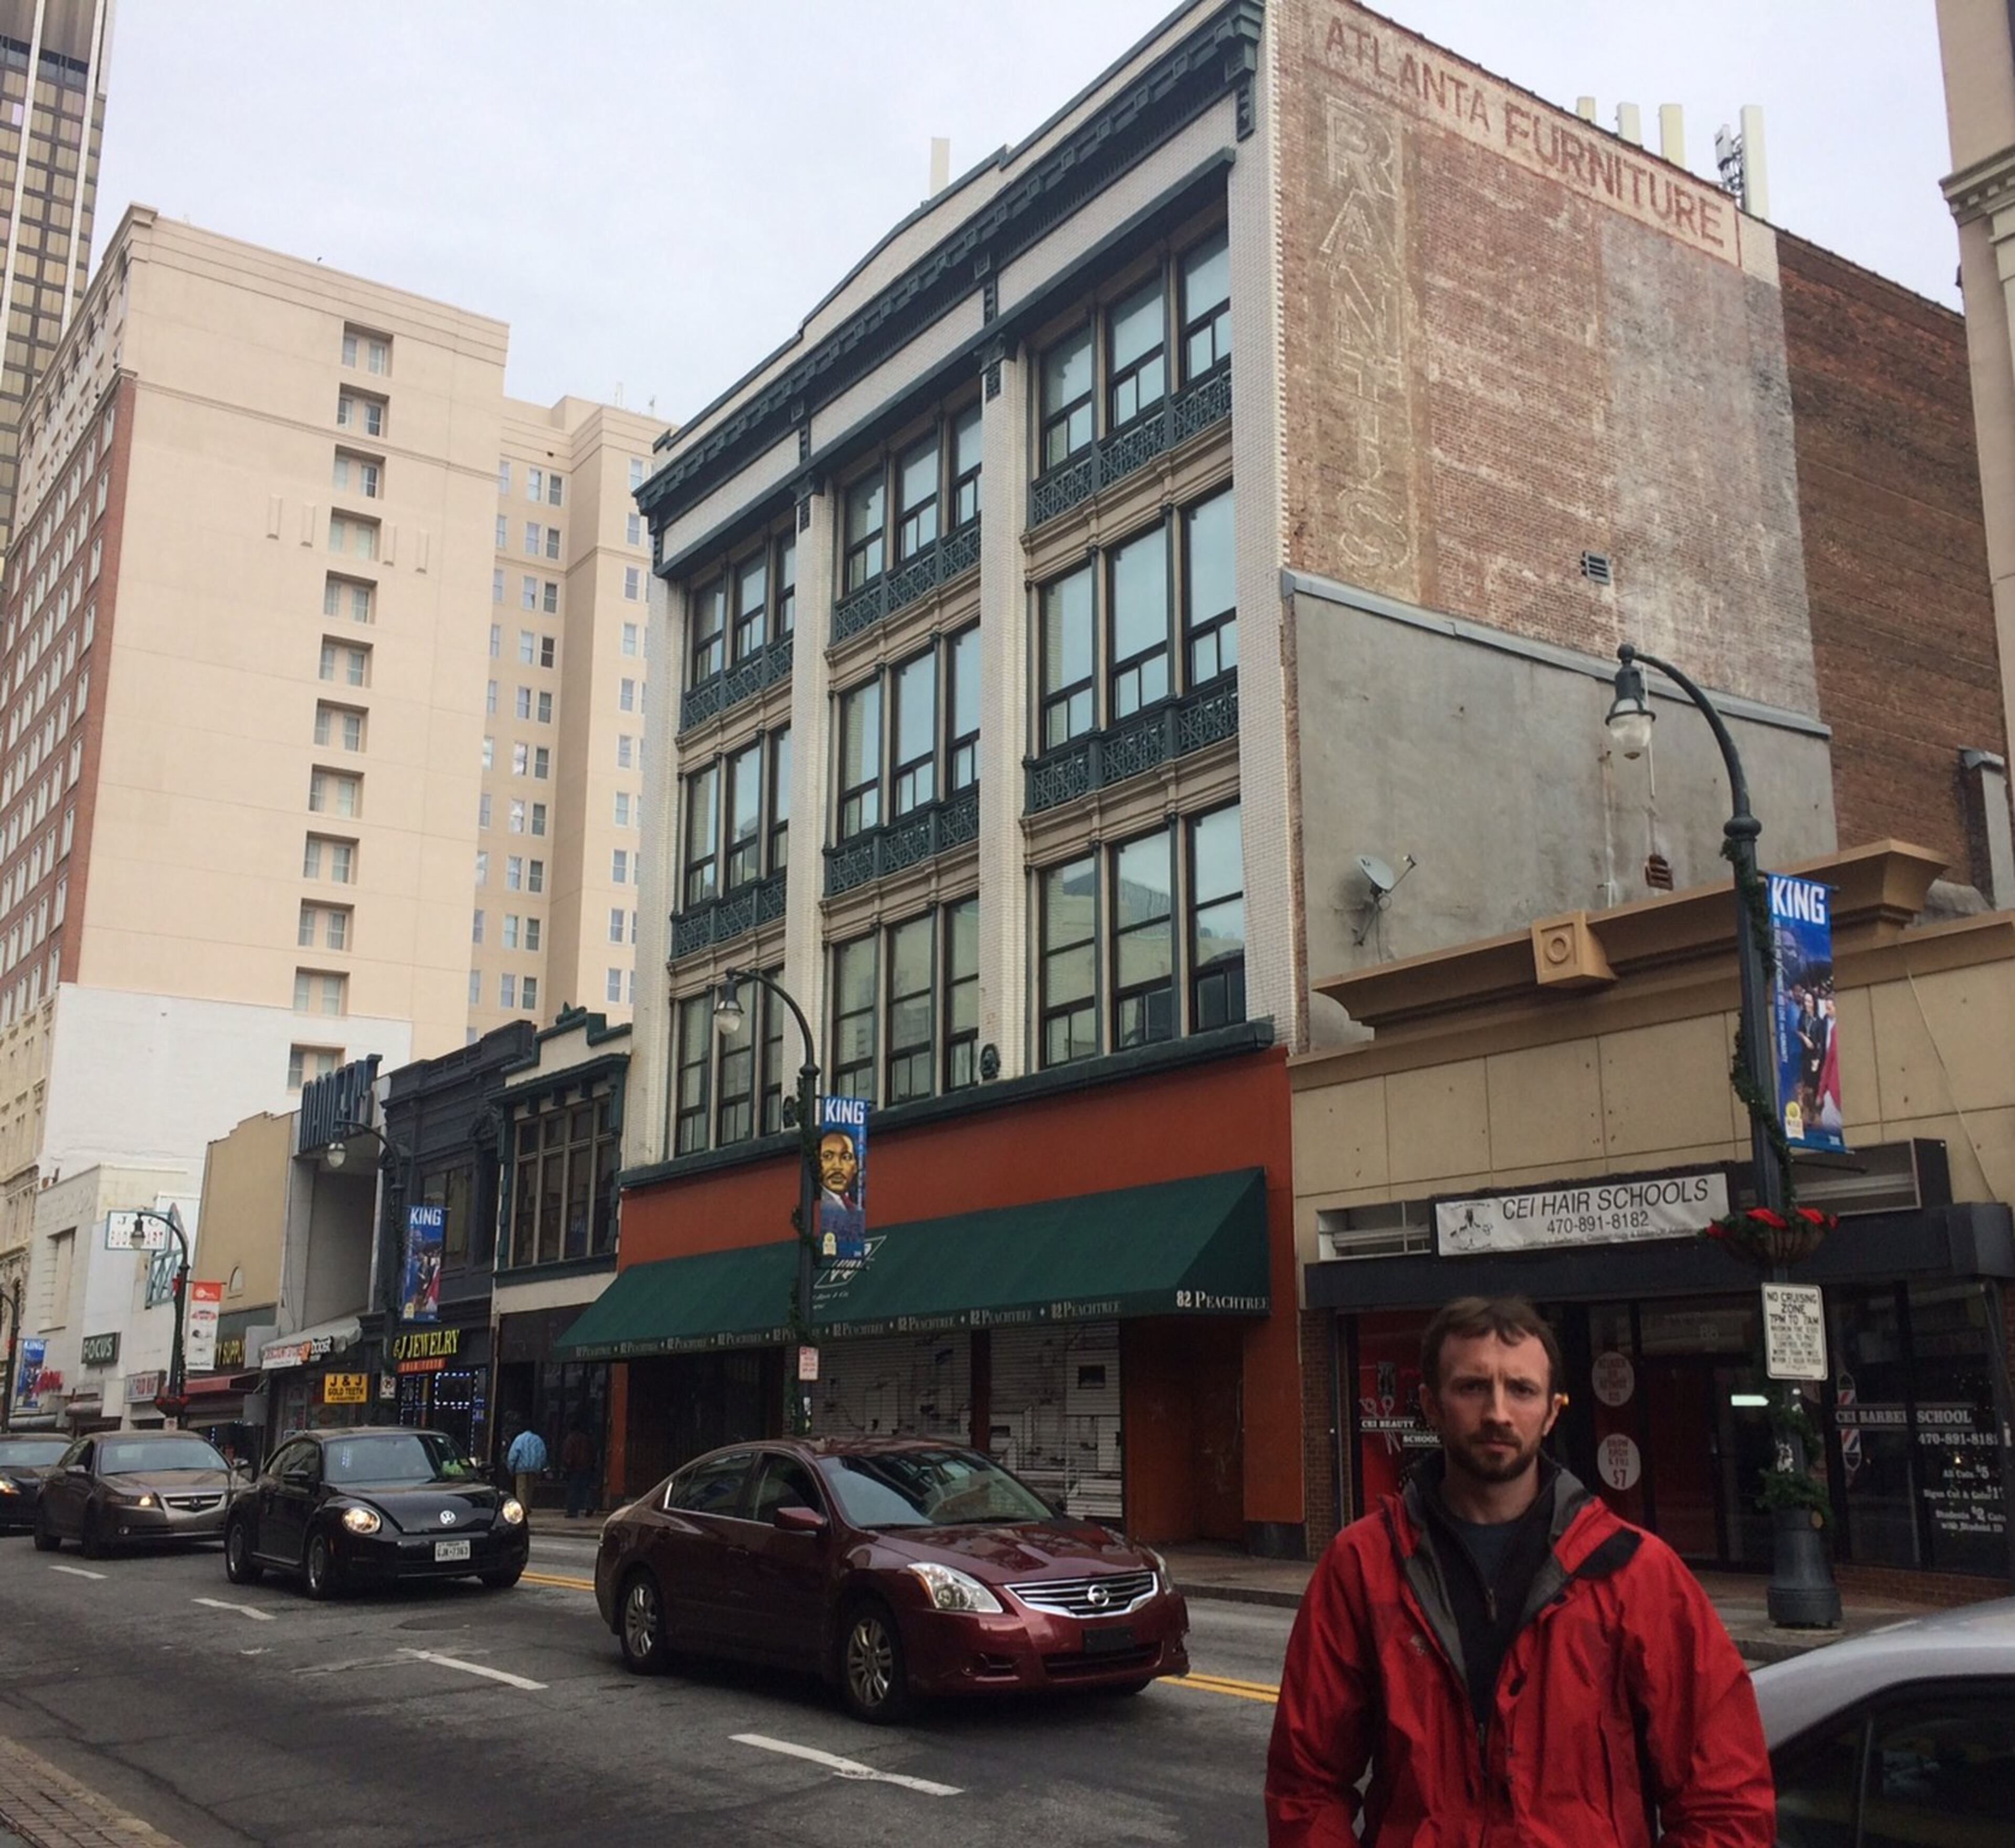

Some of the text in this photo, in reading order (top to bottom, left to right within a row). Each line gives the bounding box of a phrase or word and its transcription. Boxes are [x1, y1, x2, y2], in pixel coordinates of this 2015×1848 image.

[1325, 16, 1725, 247] ATLANTA FURNITURE
[1772, 877, 1825, 925] KING
[825, 1099, 864, 1124] KING
[1503, 1178, 1709, 1220] CEI HAIR SCHOOLS
[410, 1208, 441, 1226] KING
[1547, 1211, 1649, 1234] 470-891-8182
[1176, 1290, 1192, 1307] 82
[1767, 1292, 1817, 1304] NO CRUISING
[1051, 1303, 1063, 1319] 82
[1781, 1303, 1806, 1315] ZONE
[1788, 1314, 1799, 1325] TO
[84, 1337, 113, 1359] FOCUS
[408, 1329, 460, 1359] JEWELRY
[330, 1375, 362, 1387] J & J
[328, 1388, 344, 1396] GOLD
[1379, 1420, 1415, 1428] BEAUTY
[1836, 1410, 1856, 1423] CEI
[1916, 1410, 1972, 1424] SCHOOL
[1403, 1435, 1440, 1444] SCHOOL
[1614, 1469, 1626, 1488] $7
